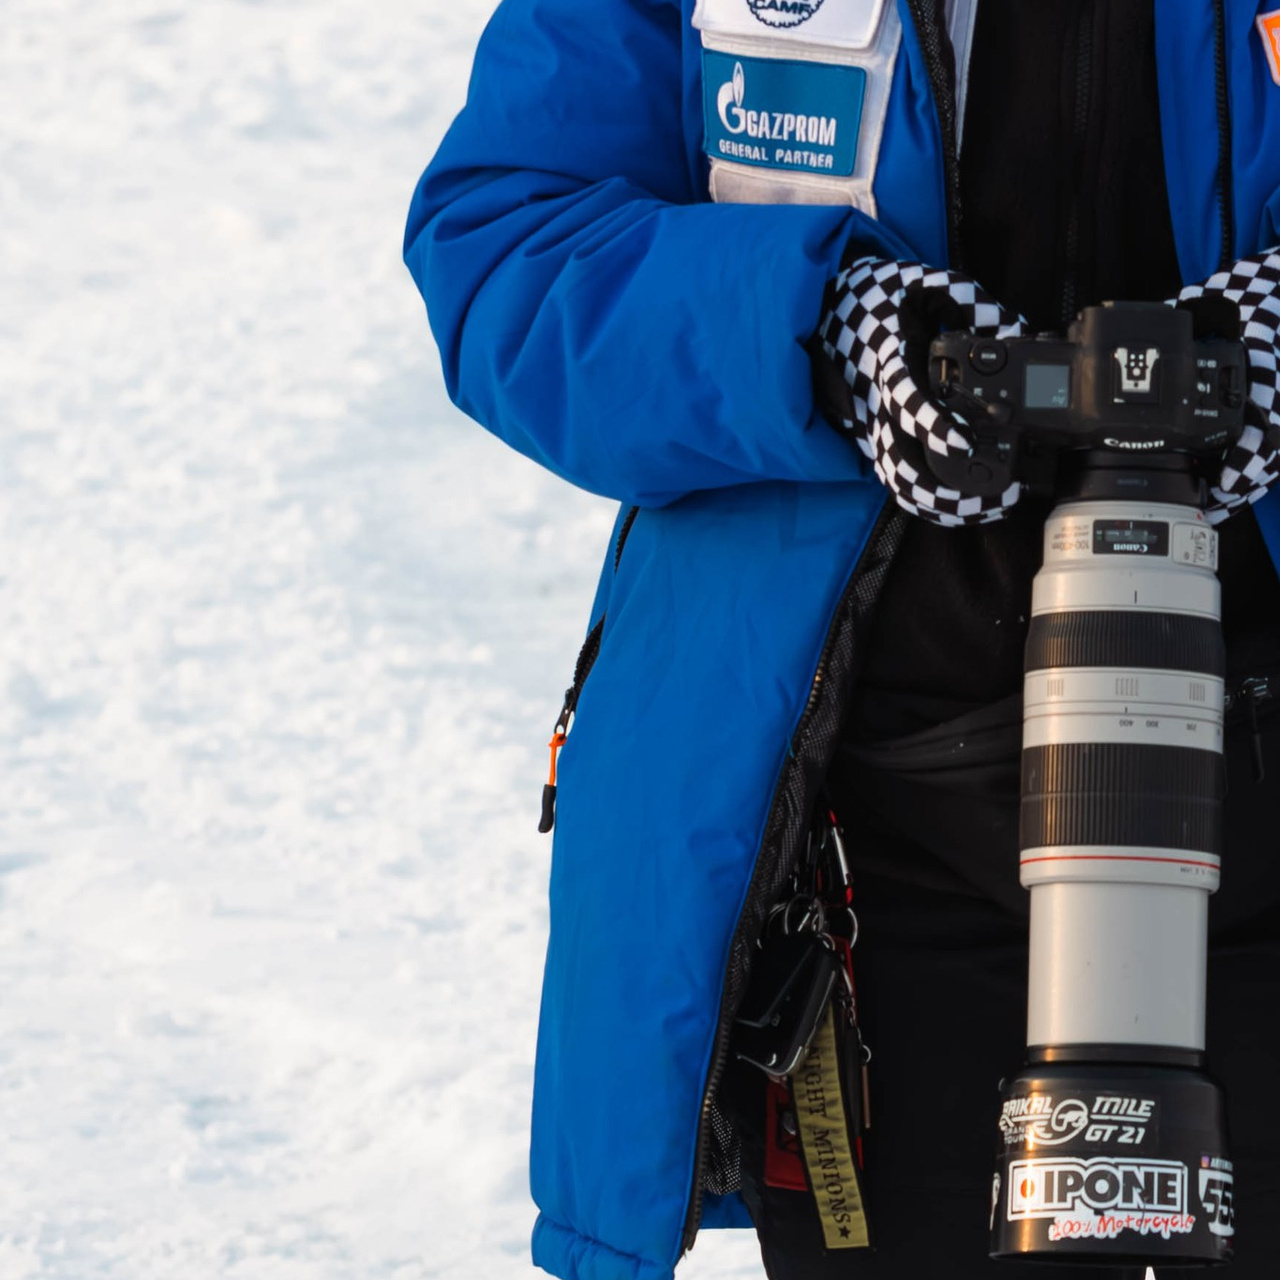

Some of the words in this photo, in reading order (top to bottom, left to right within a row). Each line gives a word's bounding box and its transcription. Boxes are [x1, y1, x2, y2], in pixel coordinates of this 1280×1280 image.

[747, 113, 837, 147] GAZPROM
[719, 139, 769, 162] GENERAL
[775, 147, 833, 169] PARTNER
[1104, 437, 1165, 449] Canon
[1113, 542, 1148, 553] Canon
[804, 1044, 828, 1117] NIGHT
[1003, 1096, 1053, 1116] BAIKAL
[1091, 1096, 1155, 1116] MILE
[1084, 1124, 1118, 1142] GT
[1118, 1126, 1146, 1144] 21
[812, 1128, 851, 1224] MINIONS
[1044, 1165, 1178, 1206] IPONE
[1096, 1213, 1196, 1237] Motorcycle
